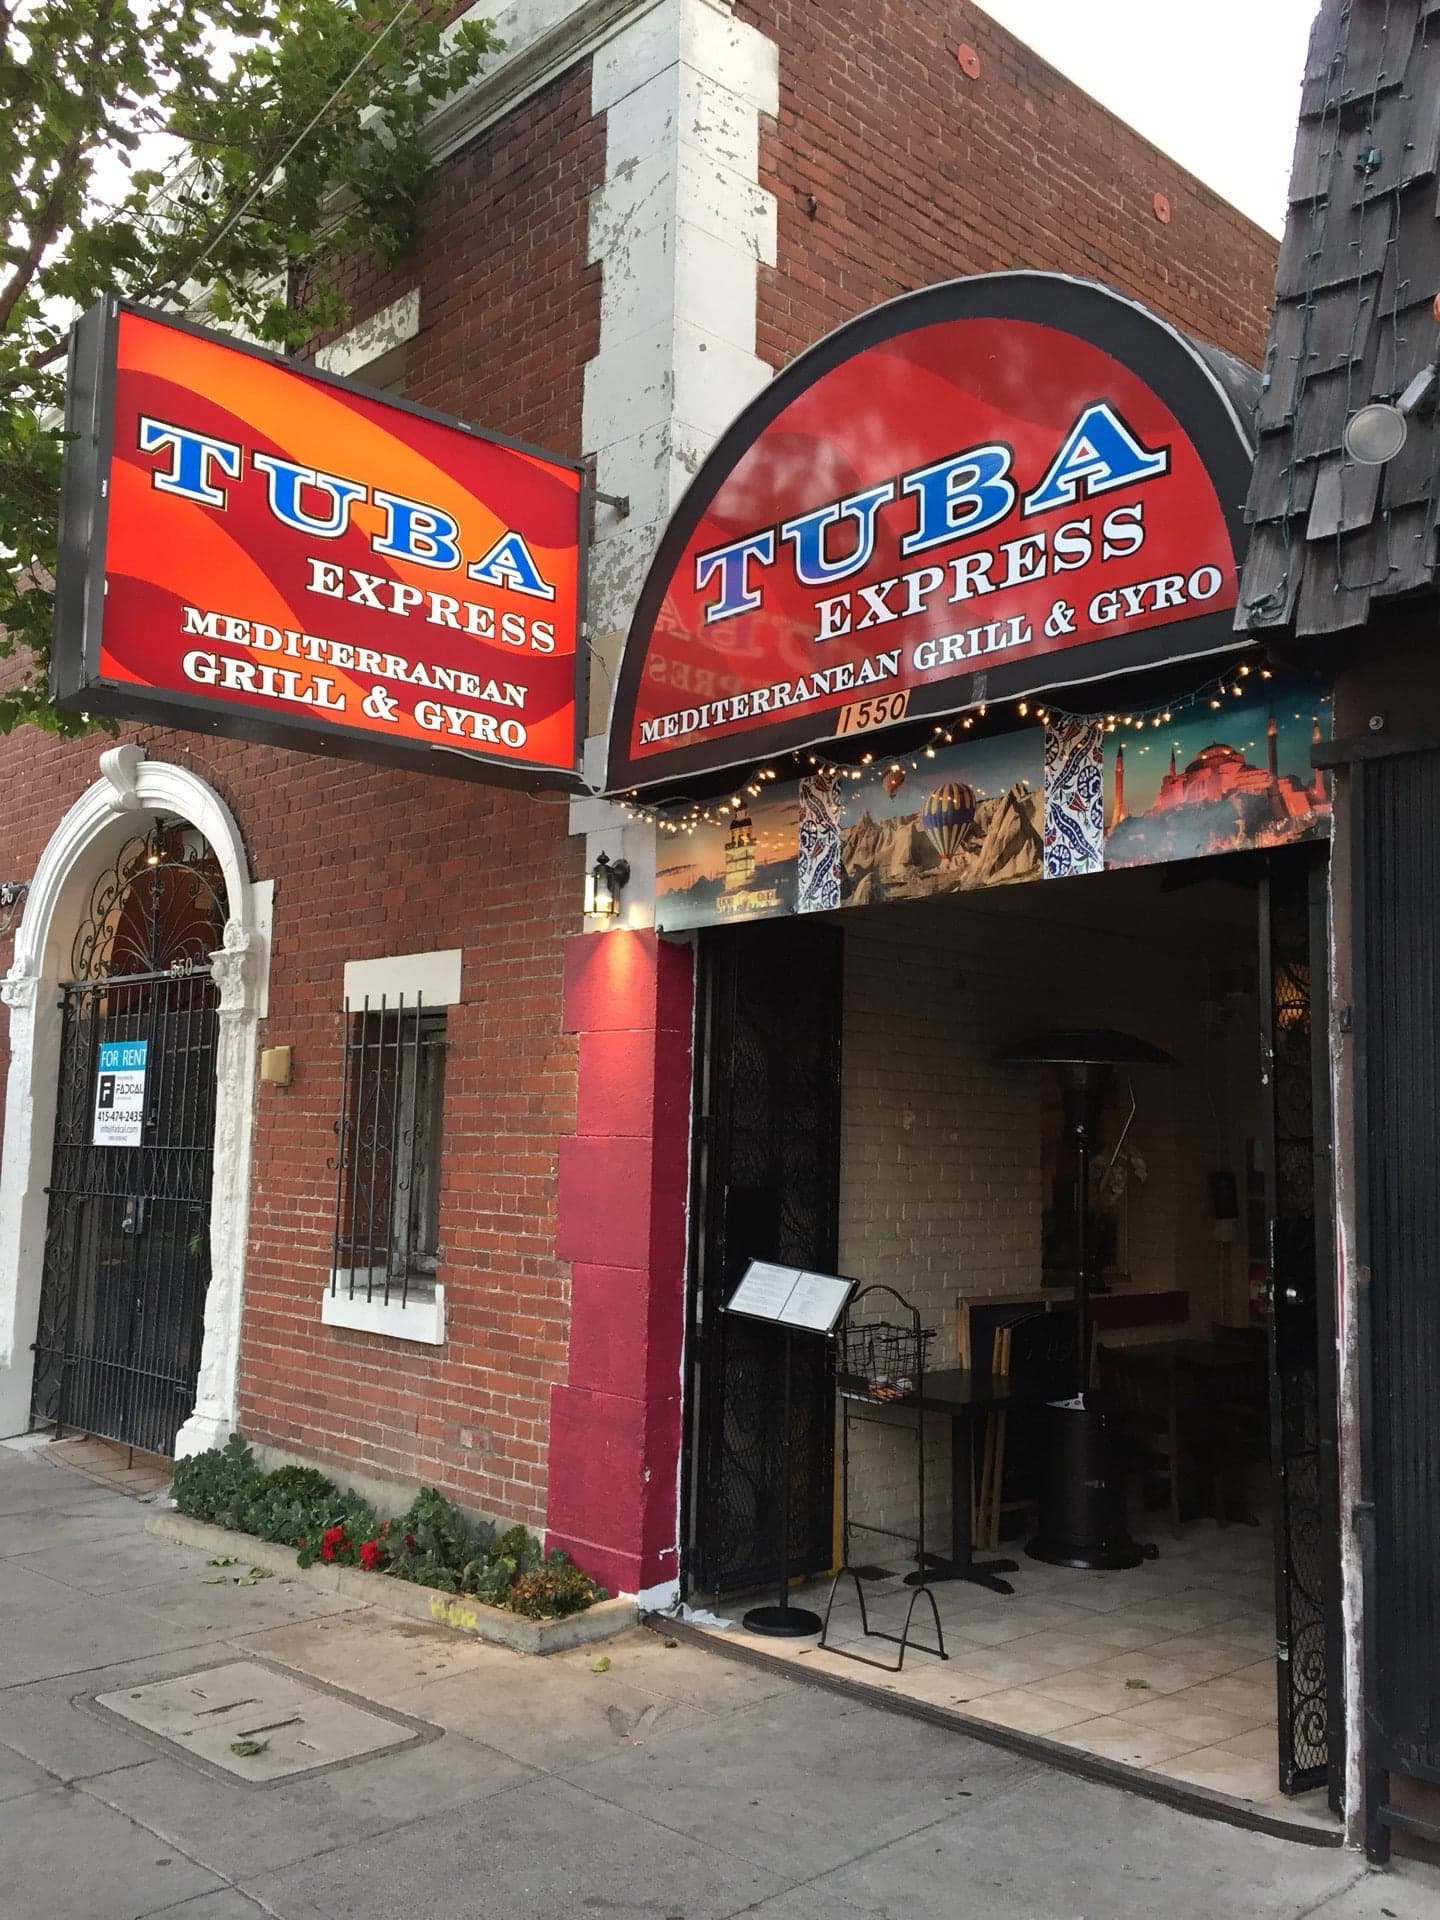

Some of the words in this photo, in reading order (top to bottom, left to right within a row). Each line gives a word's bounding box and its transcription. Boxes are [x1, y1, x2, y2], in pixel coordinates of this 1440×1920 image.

[138, 415, 556, 601] TUBA
[696, 401, 1169, 623] TUBA
[306, 558, 556, 654] EXPRESS
[814, 503, 1146, 643] EXPRESS
[182, 607, 528, 709] MEDITERRANEAN
[182, 650, 345, 711] GRILL
[363, 685, 399, 722] &
[414, 703, 528, 748] GYRO
[639, 649, 902, 744] MEDITERRANEAN
[913, 616, 1032, 671] GRILL
[1044, 601, 1076, 637] &
[1089, 565, 1223, 625] GYRO
[842, 693, 906, 733] 1550
[101, 1050, 119, 1067] FOR
[122, 1048, 147, 1067] RENT
[97, 1111, 143, 1122] 415-474-2435
